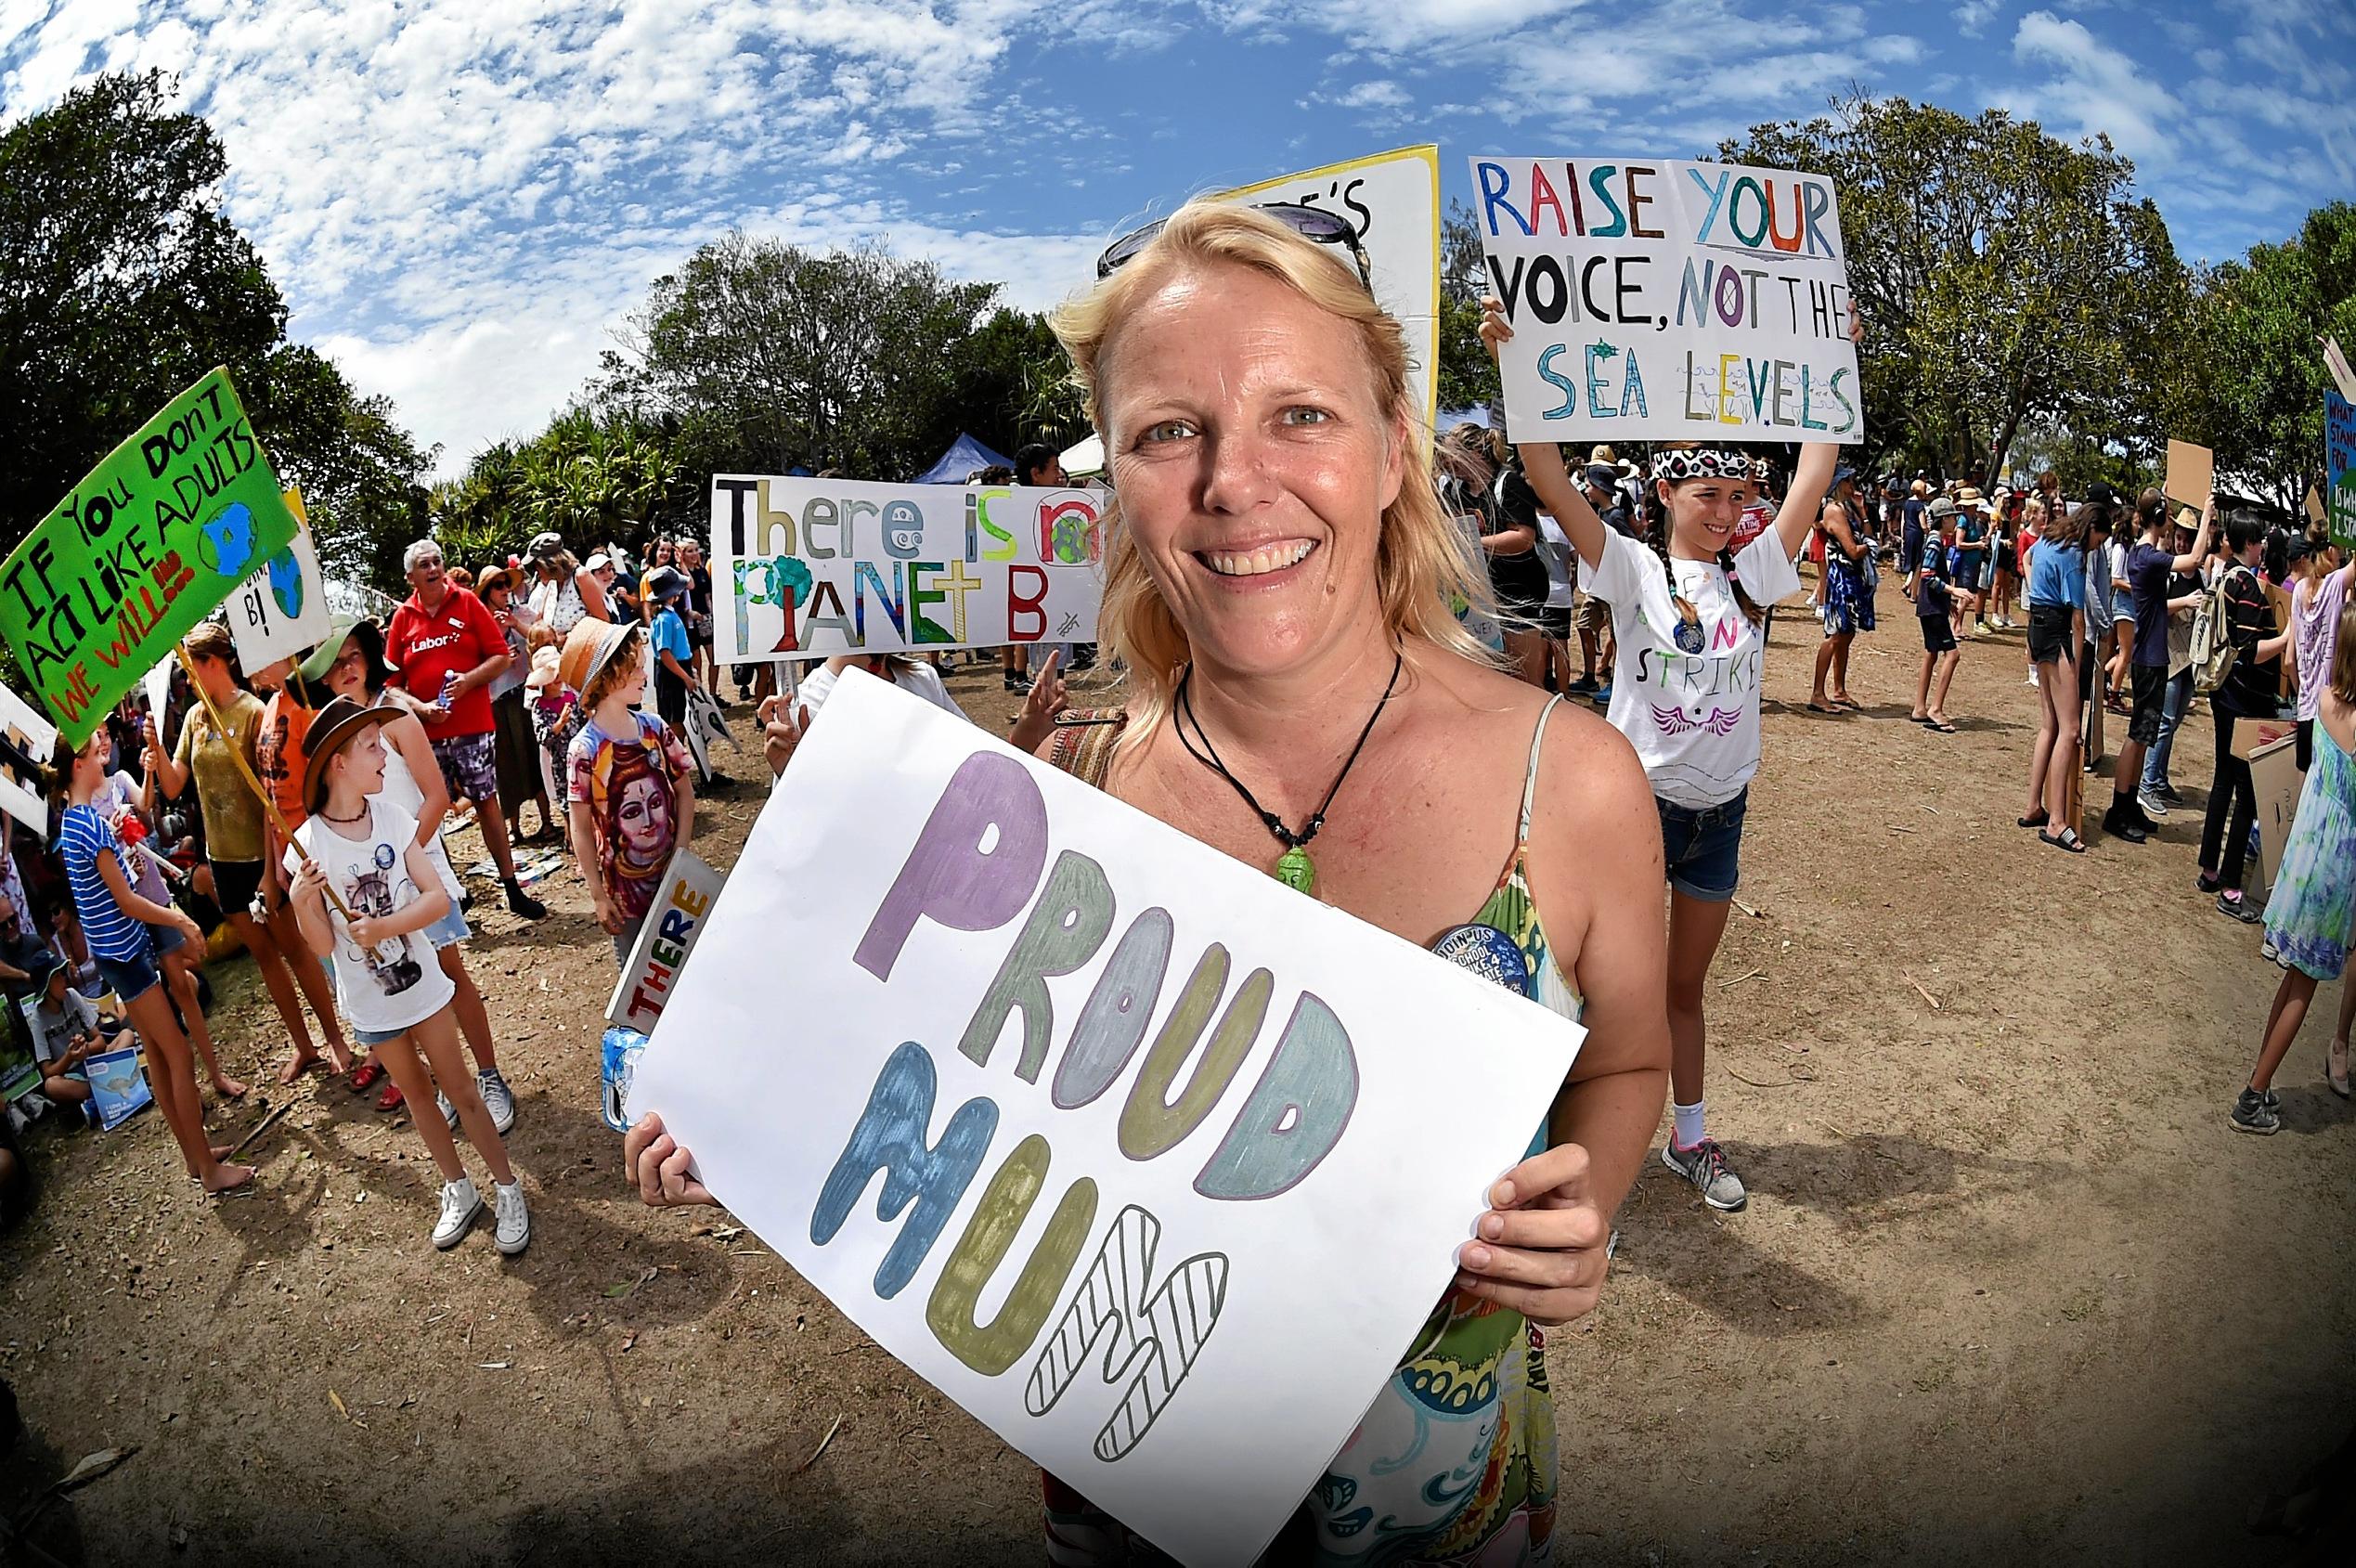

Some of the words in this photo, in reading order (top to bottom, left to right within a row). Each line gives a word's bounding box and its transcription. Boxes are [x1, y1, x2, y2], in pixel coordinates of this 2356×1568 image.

[1477, 162, 1664, 239] RAISE
[1687, 167, 1835, 258] YOUR
[1484, 254, 1668, 331] VOICE,
[1676, 255, 1768, 330] NOT
[1778, 276, 1853, 342] THE
[1537, 342, 1648, 421] SEA
[1684, 349, 1856, 435] LEVELS
[25, 592, 88, 688] ACT
[154, 416, 257, 546] ADULTS
[716, 479, 925, 559] There
[3, 538, 56, 630] IF
[244, 587, 270, 637] B!
[1008, 564, 1050, 641] B
[411, 635, 448, 654] Labor
[1636, 647, 1759, 696] STRIKE
[50, 660, 101, 724] WE
[628, 878, 709, 1019] THERE
[853, 749, 1360, 1201] PROUD
[1472, 929, 1492, 941] US
[1492, 952, 1501, 965] 4
[810, 1039, 1230, 1464] MUM
